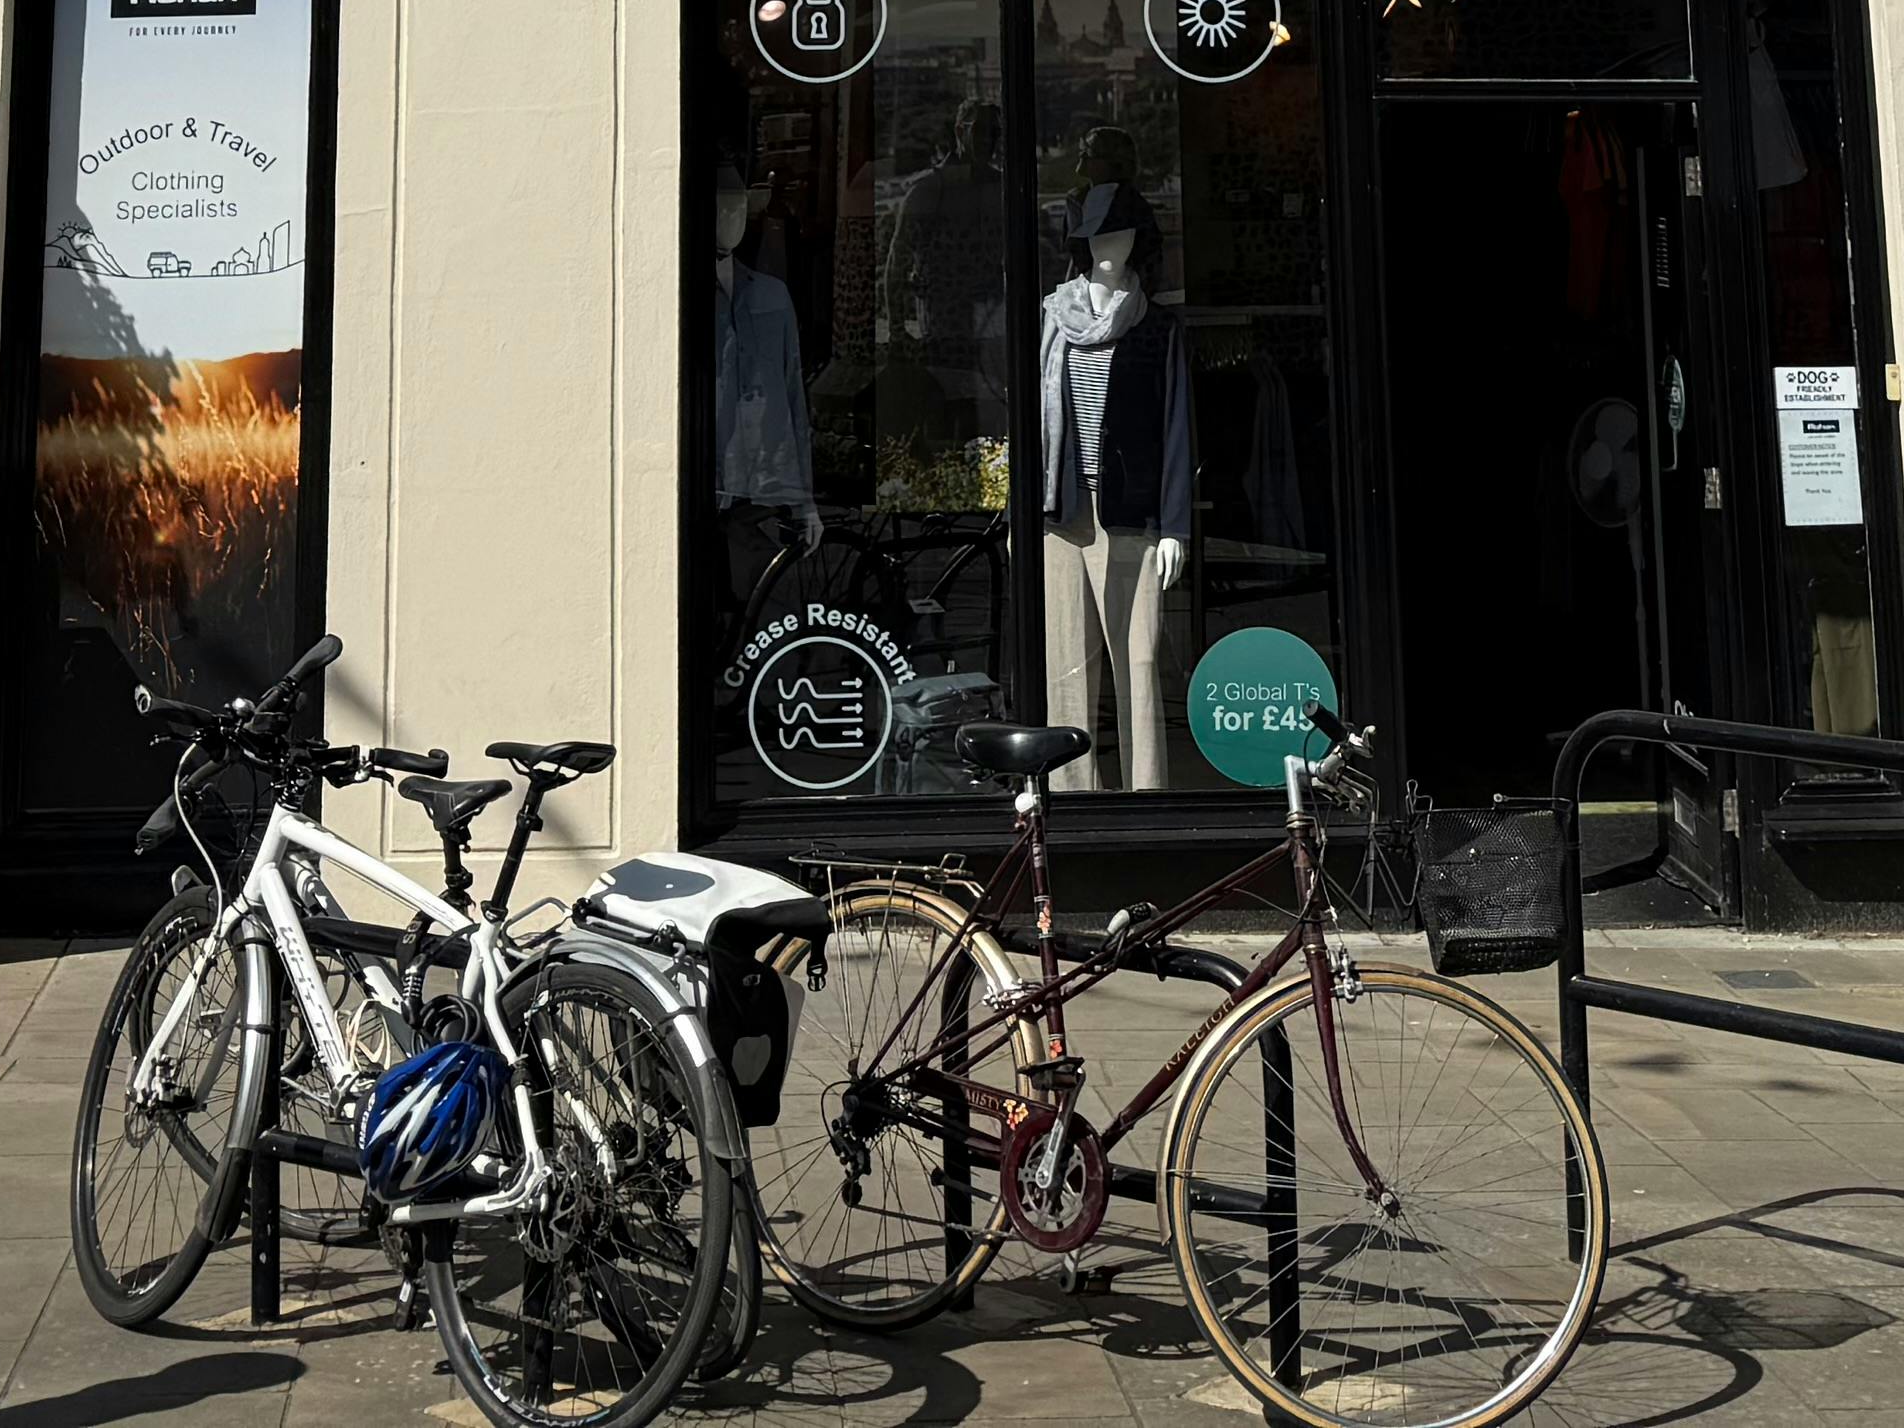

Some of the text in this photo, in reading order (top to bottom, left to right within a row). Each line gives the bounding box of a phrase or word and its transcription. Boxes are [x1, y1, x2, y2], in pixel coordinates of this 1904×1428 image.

[129, 25, 236, 37] FOR EVERY JOURNEY
[79, 117, 277, 175] Outdoor & Travel
[132, 171, 224, 194] Clothing
[116, 199, 238, 224] Specialists
[1797, 371, 1828, 384] DOG
[723, 603, 917, 688] Crease Resistant
[1206, 682, 1321, 701] 2 Global T's
[1212, 705, 1254, 731] for
